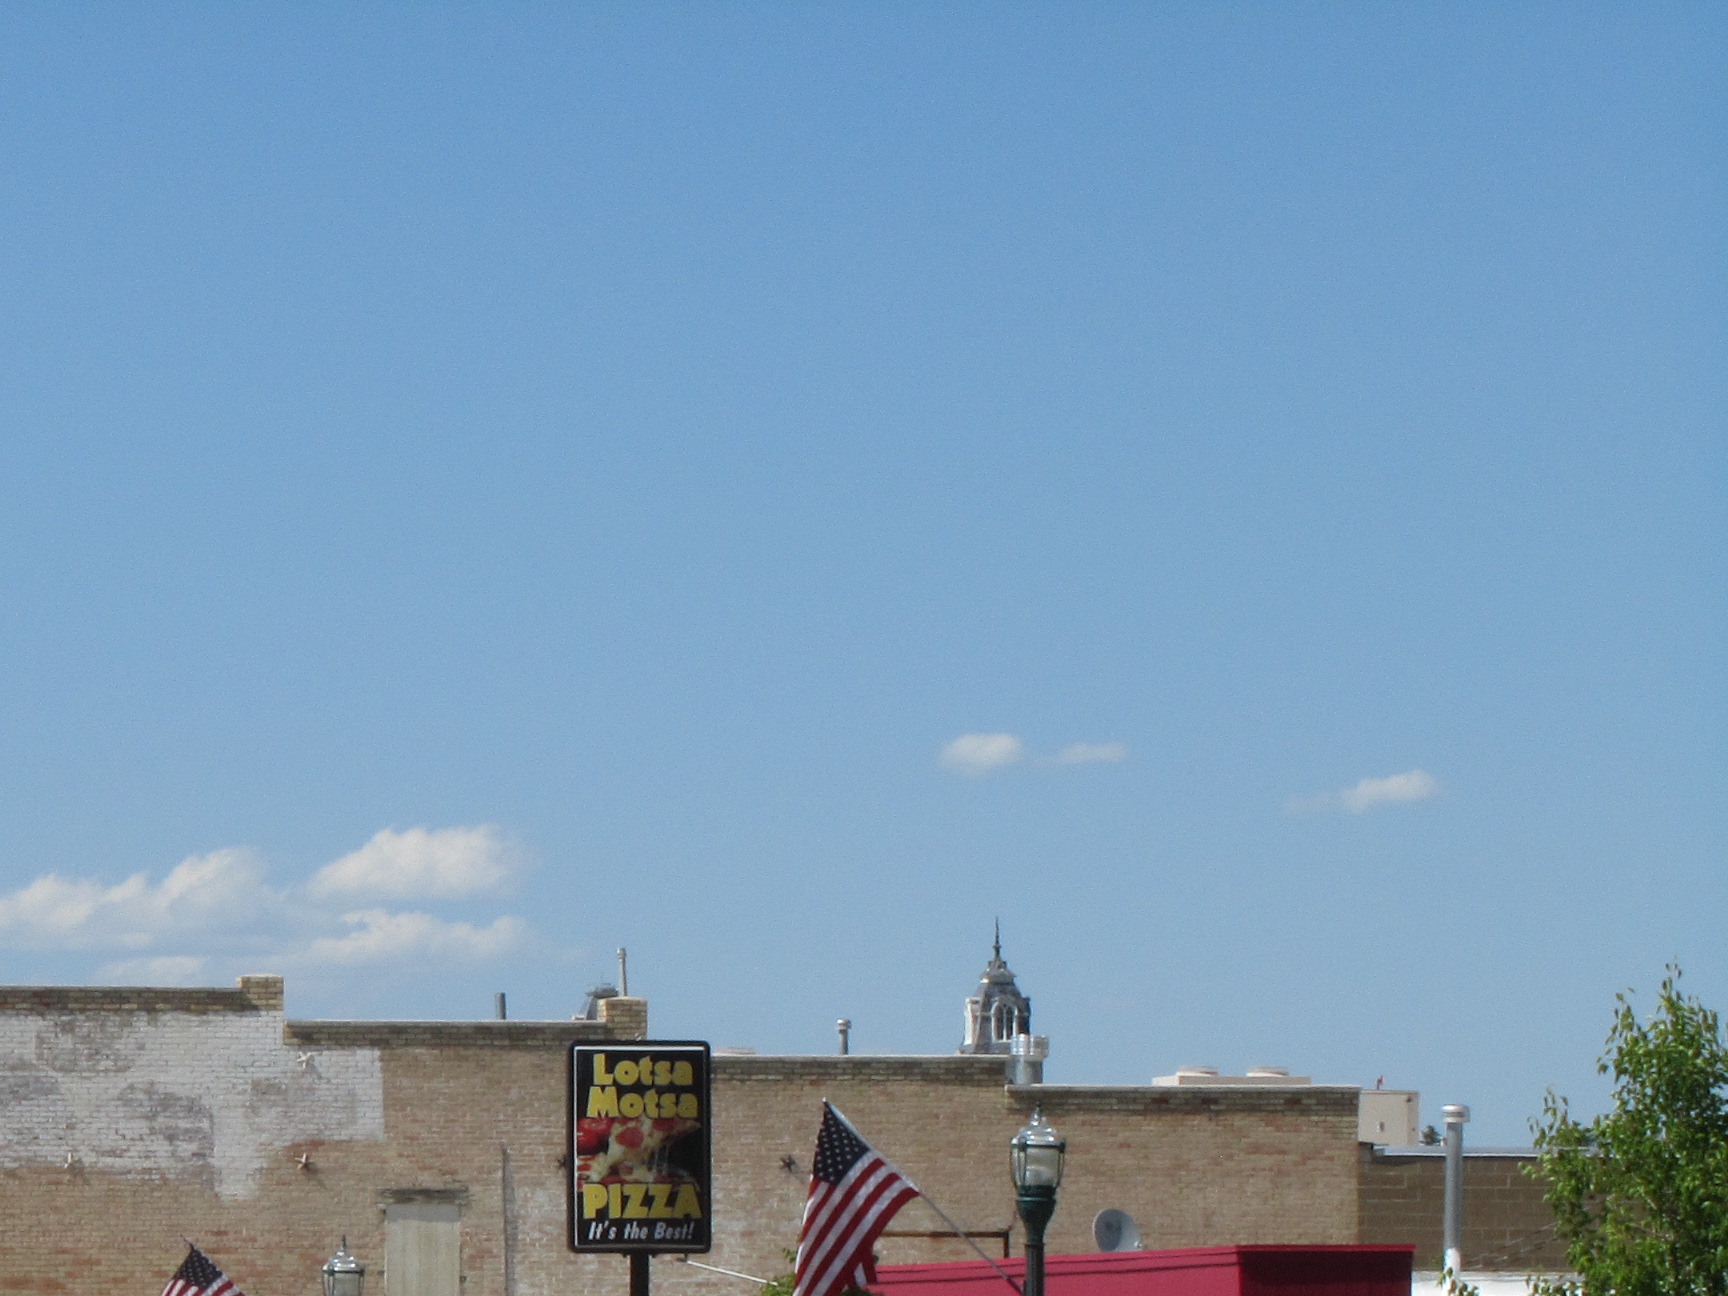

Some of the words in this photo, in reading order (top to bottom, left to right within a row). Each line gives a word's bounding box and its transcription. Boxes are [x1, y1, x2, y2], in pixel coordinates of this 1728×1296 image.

[593, 1053, 693, 1085] Lotsa
[586, 1086, 698, 1118] Motsa
[583, 1183, 702, 1219] PIZZA
[588, 1220, 617, 1240] It's
[624, 1221, 648, 1240] the
[654, 1221, 695, 1240] Best!
